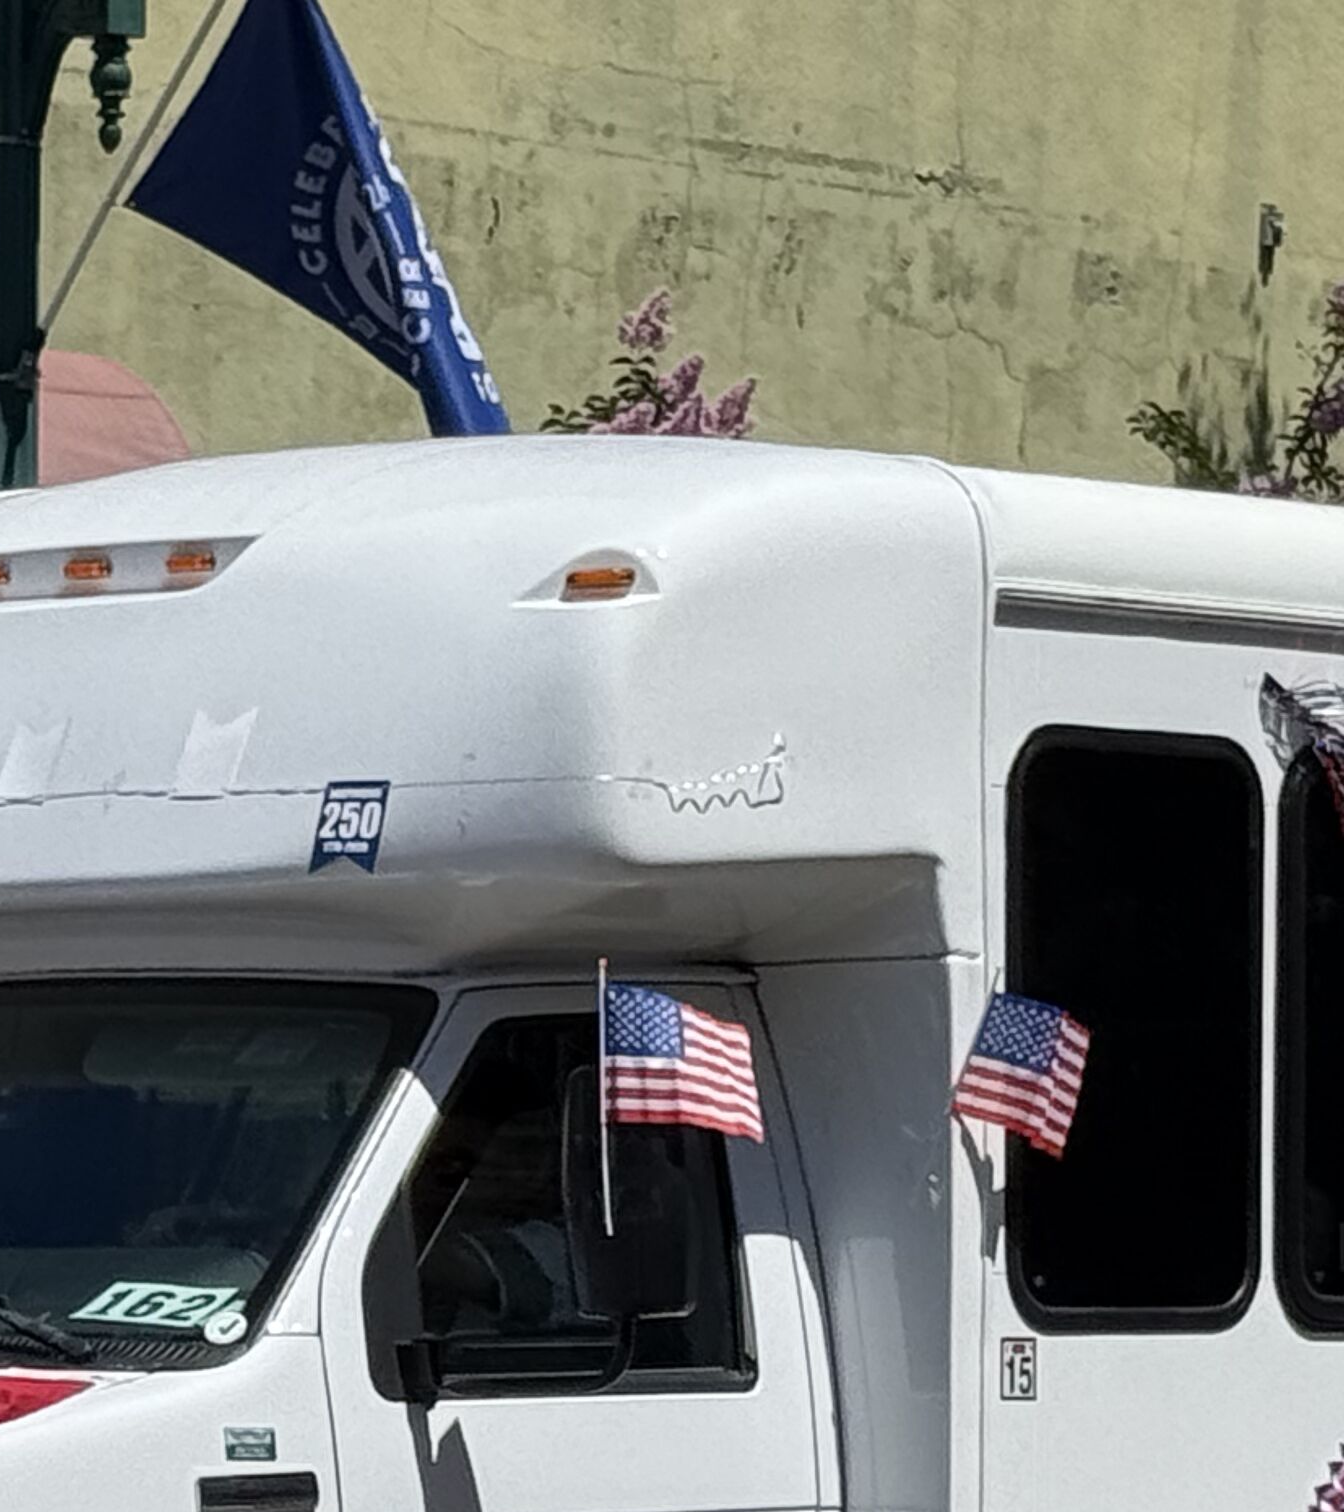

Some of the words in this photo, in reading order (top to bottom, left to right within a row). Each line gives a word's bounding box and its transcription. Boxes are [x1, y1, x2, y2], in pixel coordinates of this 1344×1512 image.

[319, 801, 383, 839] 250
[85, 1288, 218, 1321] 162
[1005, 1355, 1032, 1394] 15
